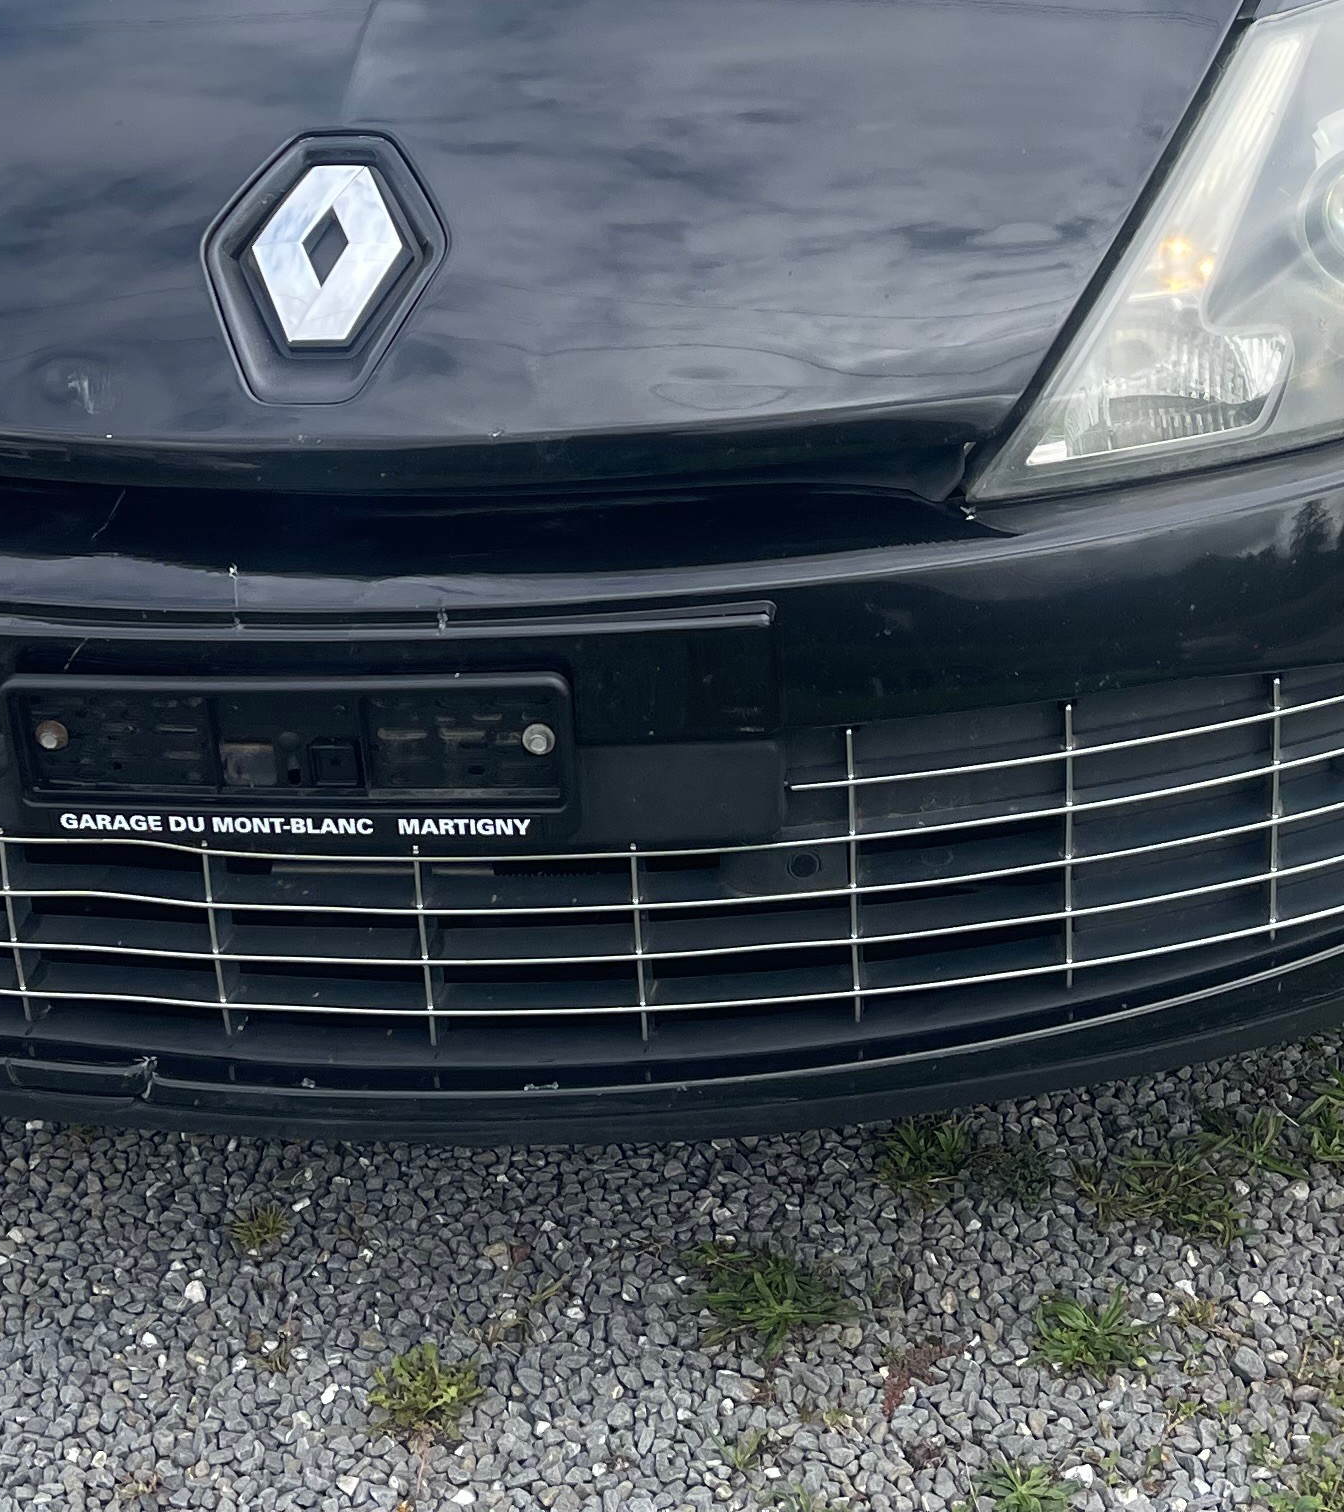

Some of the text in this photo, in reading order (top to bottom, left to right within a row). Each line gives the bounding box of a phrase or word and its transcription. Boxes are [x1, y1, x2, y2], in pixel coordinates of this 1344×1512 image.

[60, 813, 531, 835] GARAGE DU MONT-BLANC MARTIGNY
